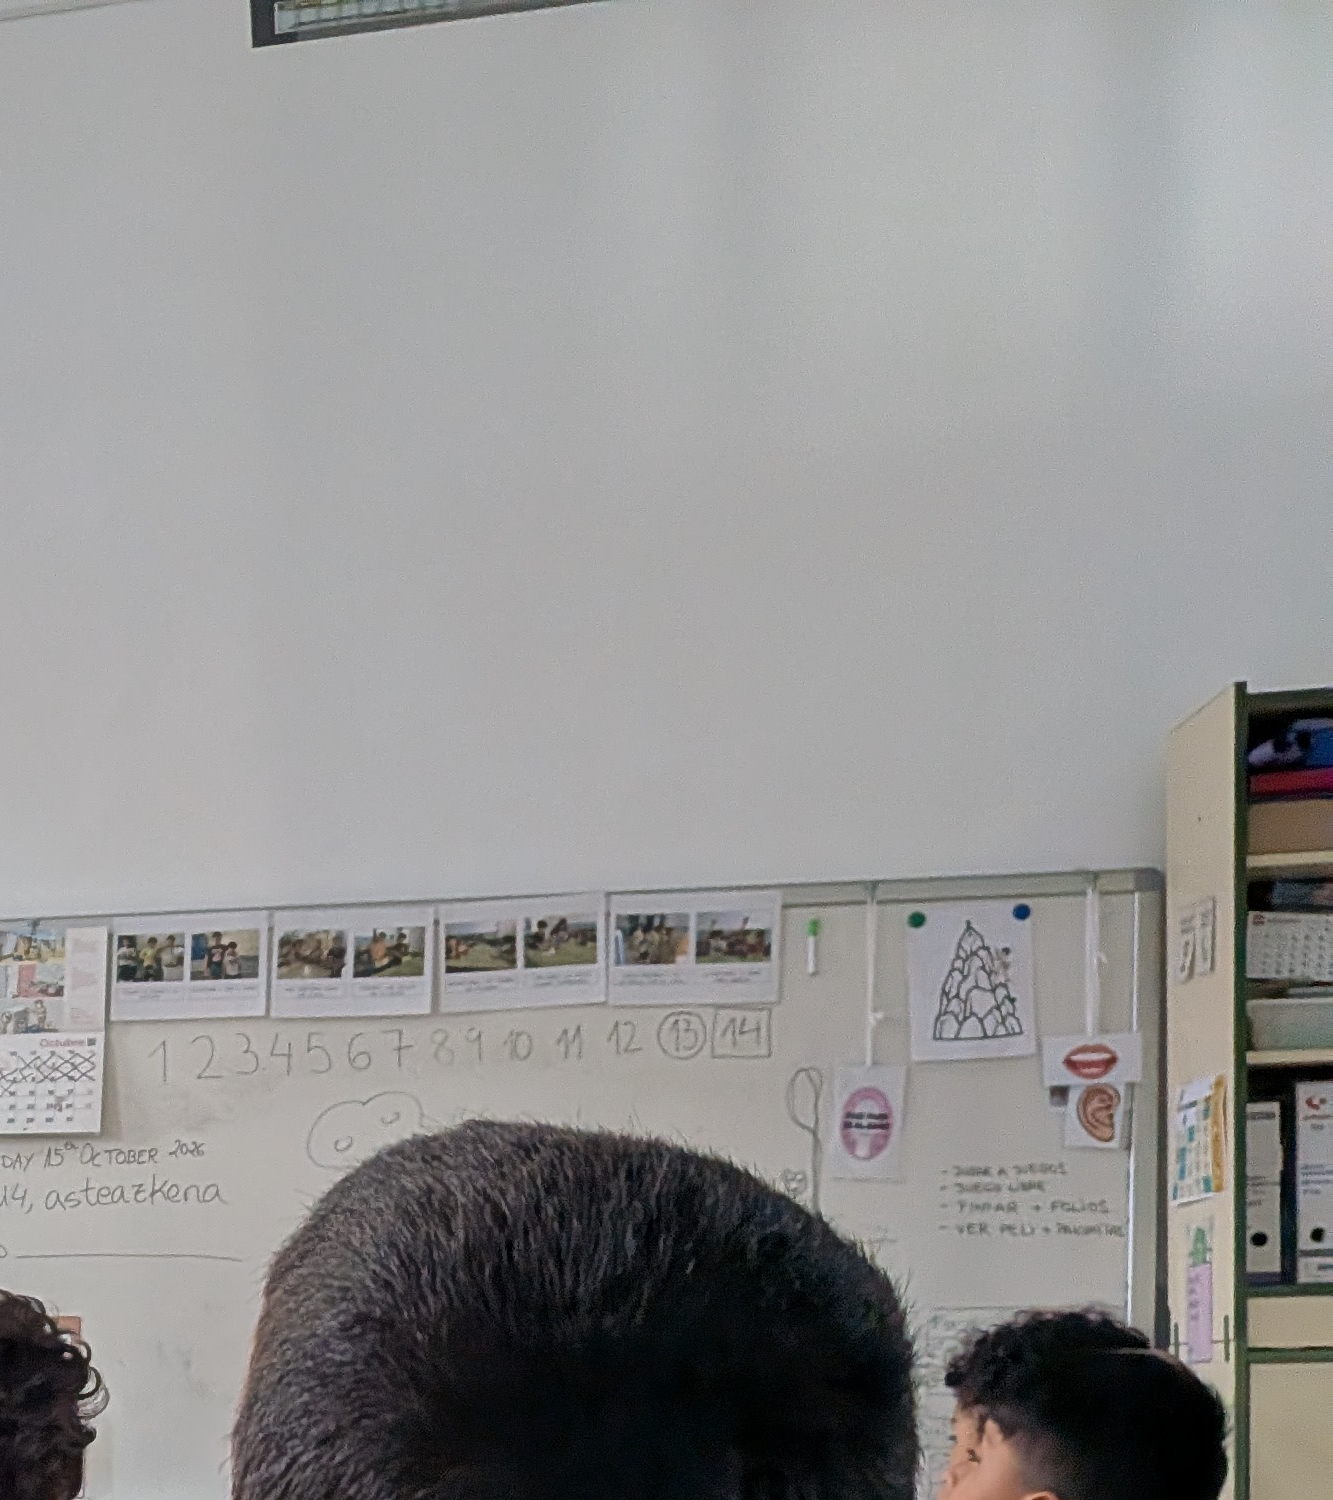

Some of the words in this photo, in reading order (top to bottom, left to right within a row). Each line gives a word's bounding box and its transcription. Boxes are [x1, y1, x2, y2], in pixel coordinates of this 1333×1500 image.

[147, 1038, 167, 1083] 1
[191, 1033, 225, 1079] 2
[270, 1031, 294, 1077] 4
[306, 1031, 333, 1075] 5
[347, 1032, 372, 1071] 6
[381, 1028, 414, 1069] 7
[430, 1027, 455, 1066] 8
[464, 1026, 483, 1061] 9
[502, 1028, 533, 1061] 10
[555, 1024, 583, 1061] 11
[606, 1020, 642, 1056] 12
[668, 1017, 700, 1053] 13
[719, 1015, 762, 1047] 14
[44, 1173, 229, 1212] asteazkena
